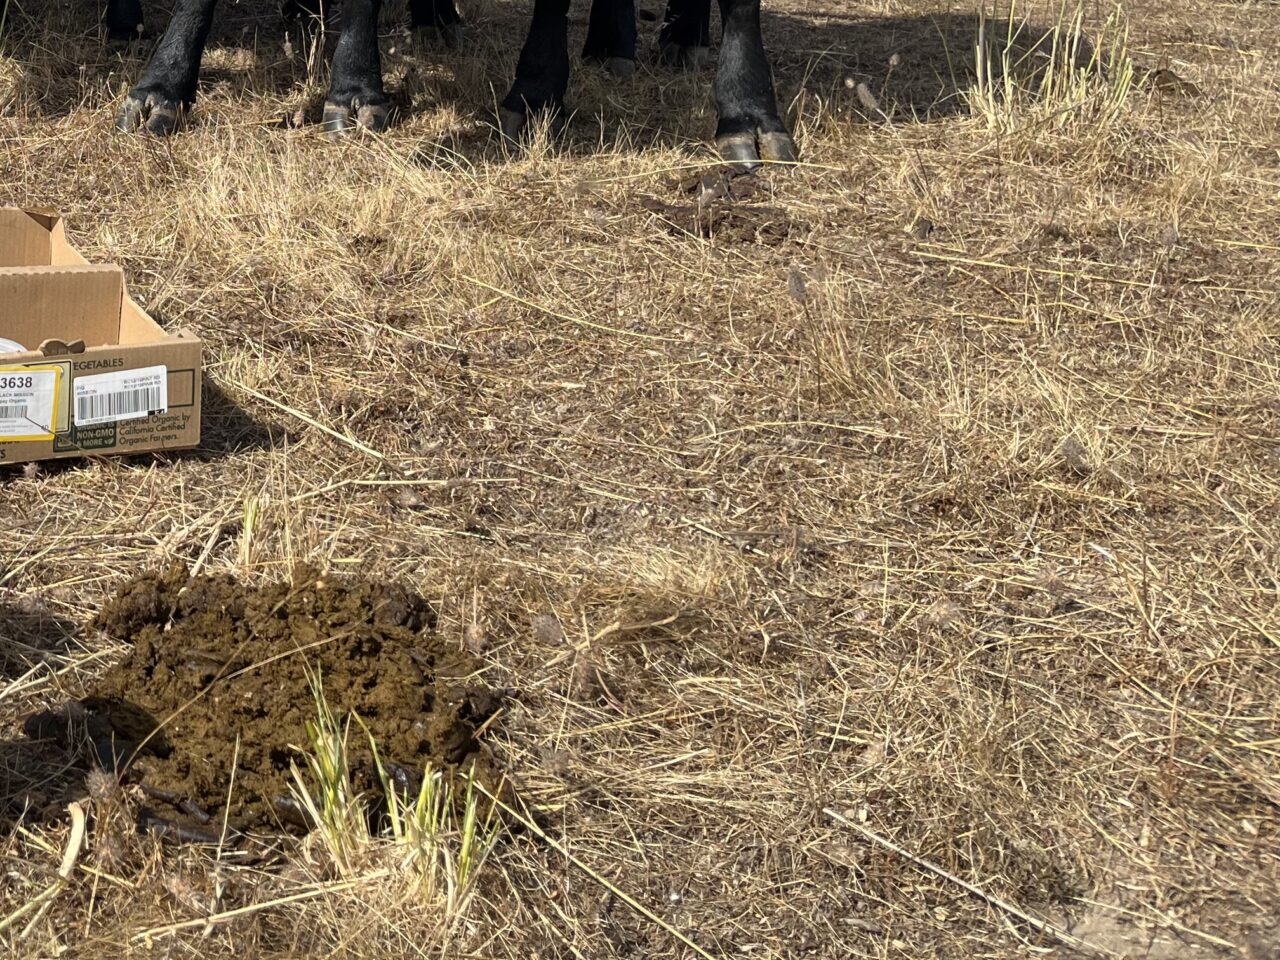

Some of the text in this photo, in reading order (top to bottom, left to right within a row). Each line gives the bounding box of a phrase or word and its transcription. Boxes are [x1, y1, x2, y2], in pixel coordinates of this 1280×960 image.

[73, 358, 123, 370] EGETABLES
[120, 416, 149, 426] Certified
[152, 415, 180, 424] Organic
[182, 412, 191, 422] by
[77, 428, 114, 439] NON-GMO
[119, 421, 185, 435] California Certified
[83, 438, 103, 446] MORE
[119, 436, 148, 446] Organic
